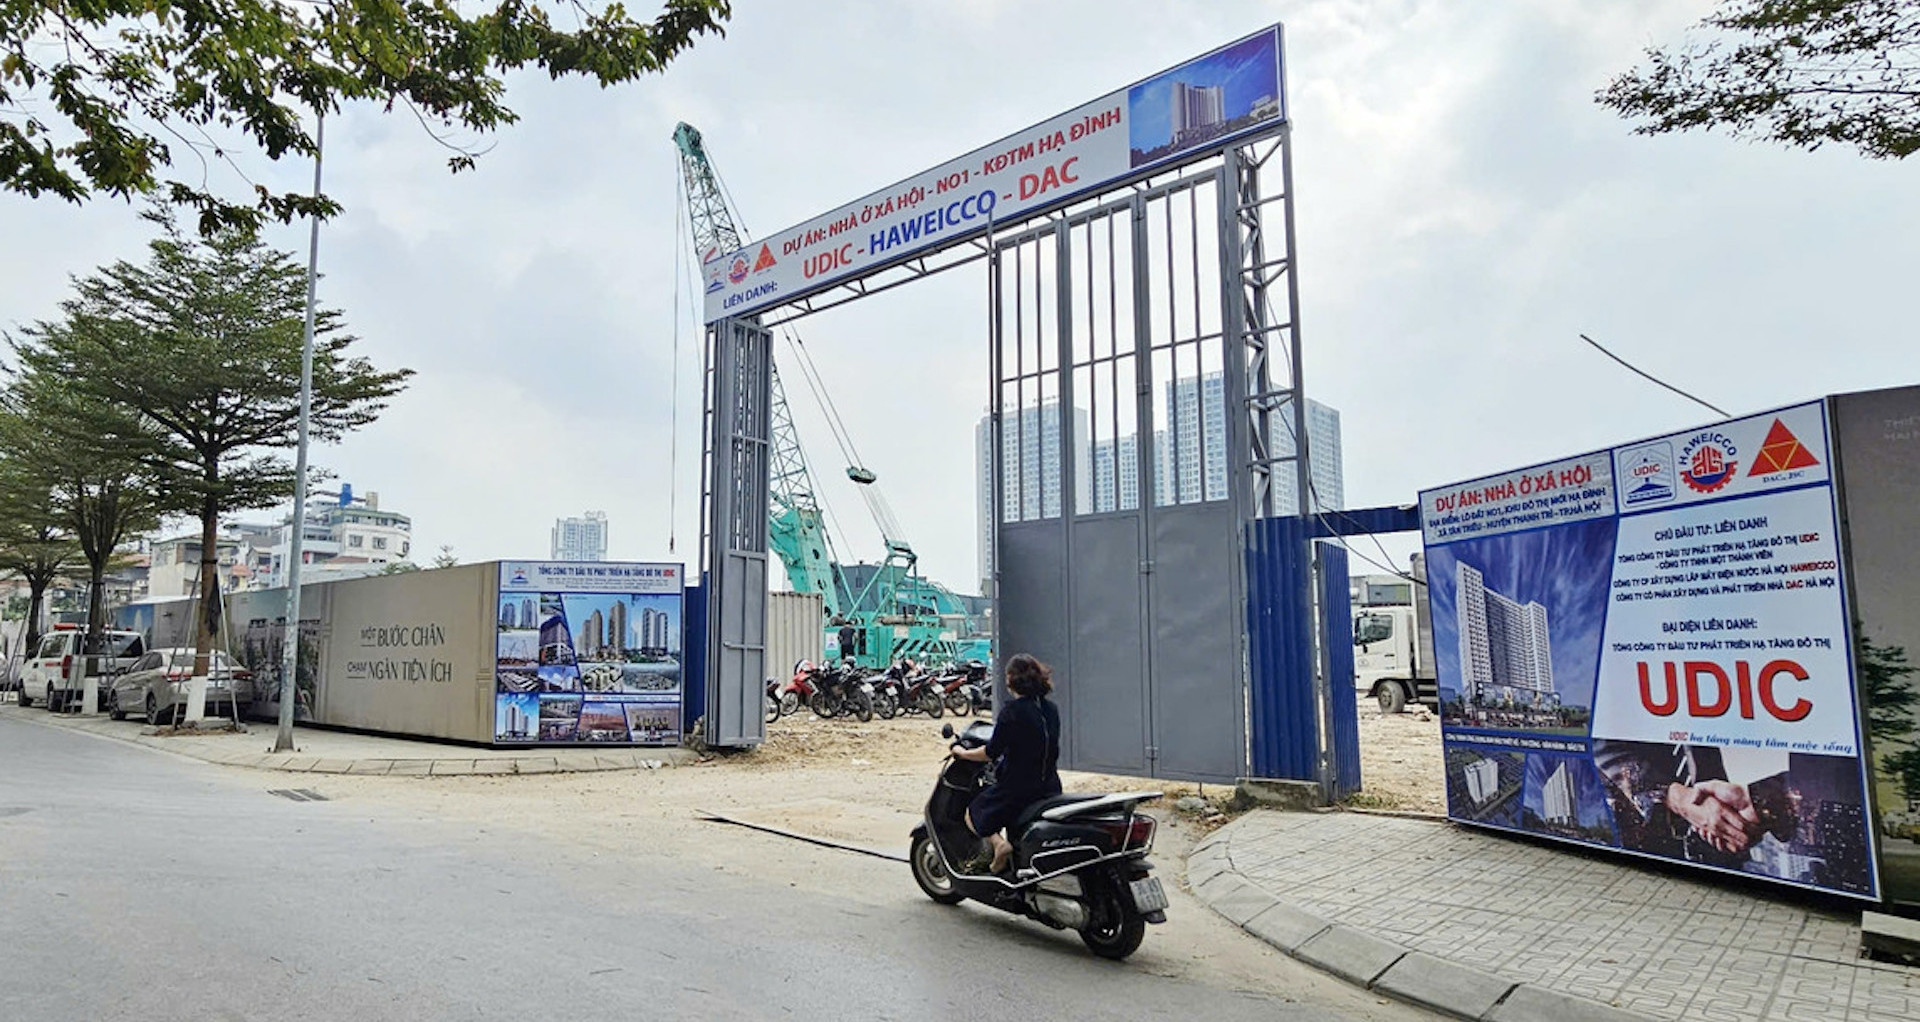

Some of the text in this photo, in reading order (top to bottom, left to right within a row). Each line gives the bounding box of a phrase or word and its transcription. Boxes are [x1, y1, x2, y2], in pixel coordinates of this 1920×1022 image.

[783, 235, 803, 255] DỰ
[804, 228, 827, 247] ÁN:
[829, 212, 858, 237] NHÀ
[861, 205, 873, 224] Ở
[875, 197, 894, 219] XÃ
[897, 186, 924, 210] HỘI
[936, 169, 969, 194] NO1
[983, 142, 1035, 176] KĐTM
[1038, 130, 1066, 154] HẠ
[1069, 106, 1121, 142] ĐÌNH
[803, 243, 853, 279] UDIC
[869, 190, 997, 255] HAWEICCO
[1019, 156, 1079, 201] DAC
[723, 281, 778, 309] LIÊN DANH:
[1679, 432, 1738, 465] HAWEICCO
[1633, 463, 1661, 476] UDIC
[1436, 464, 1592, 512] DỰ ÁN: NHÀ Ở XÃ HỘI
[1654, 516, 1768, 541] CHỦ ĐẦU TƯ: LIÊN DANH
[1799, 532, 1819, 543] UDIC
[1790, 560, 1836, 573] HAWEICCO
[1785, 579, 1803, 590] DAC
[377, 625, 409, 647] BƯỚC
[412, 623, 445, 647] CHÂN
[1662, 617, 1758, 635] ĐẠI DIỆN LIÊN DANH:
[401, 658, 427, 684] TIỆN
[430, 658, 452, 682] ÍCH
[1636, 659, 1813, 722] UDIC
[1668, 731, 1689, 741] UDIC
